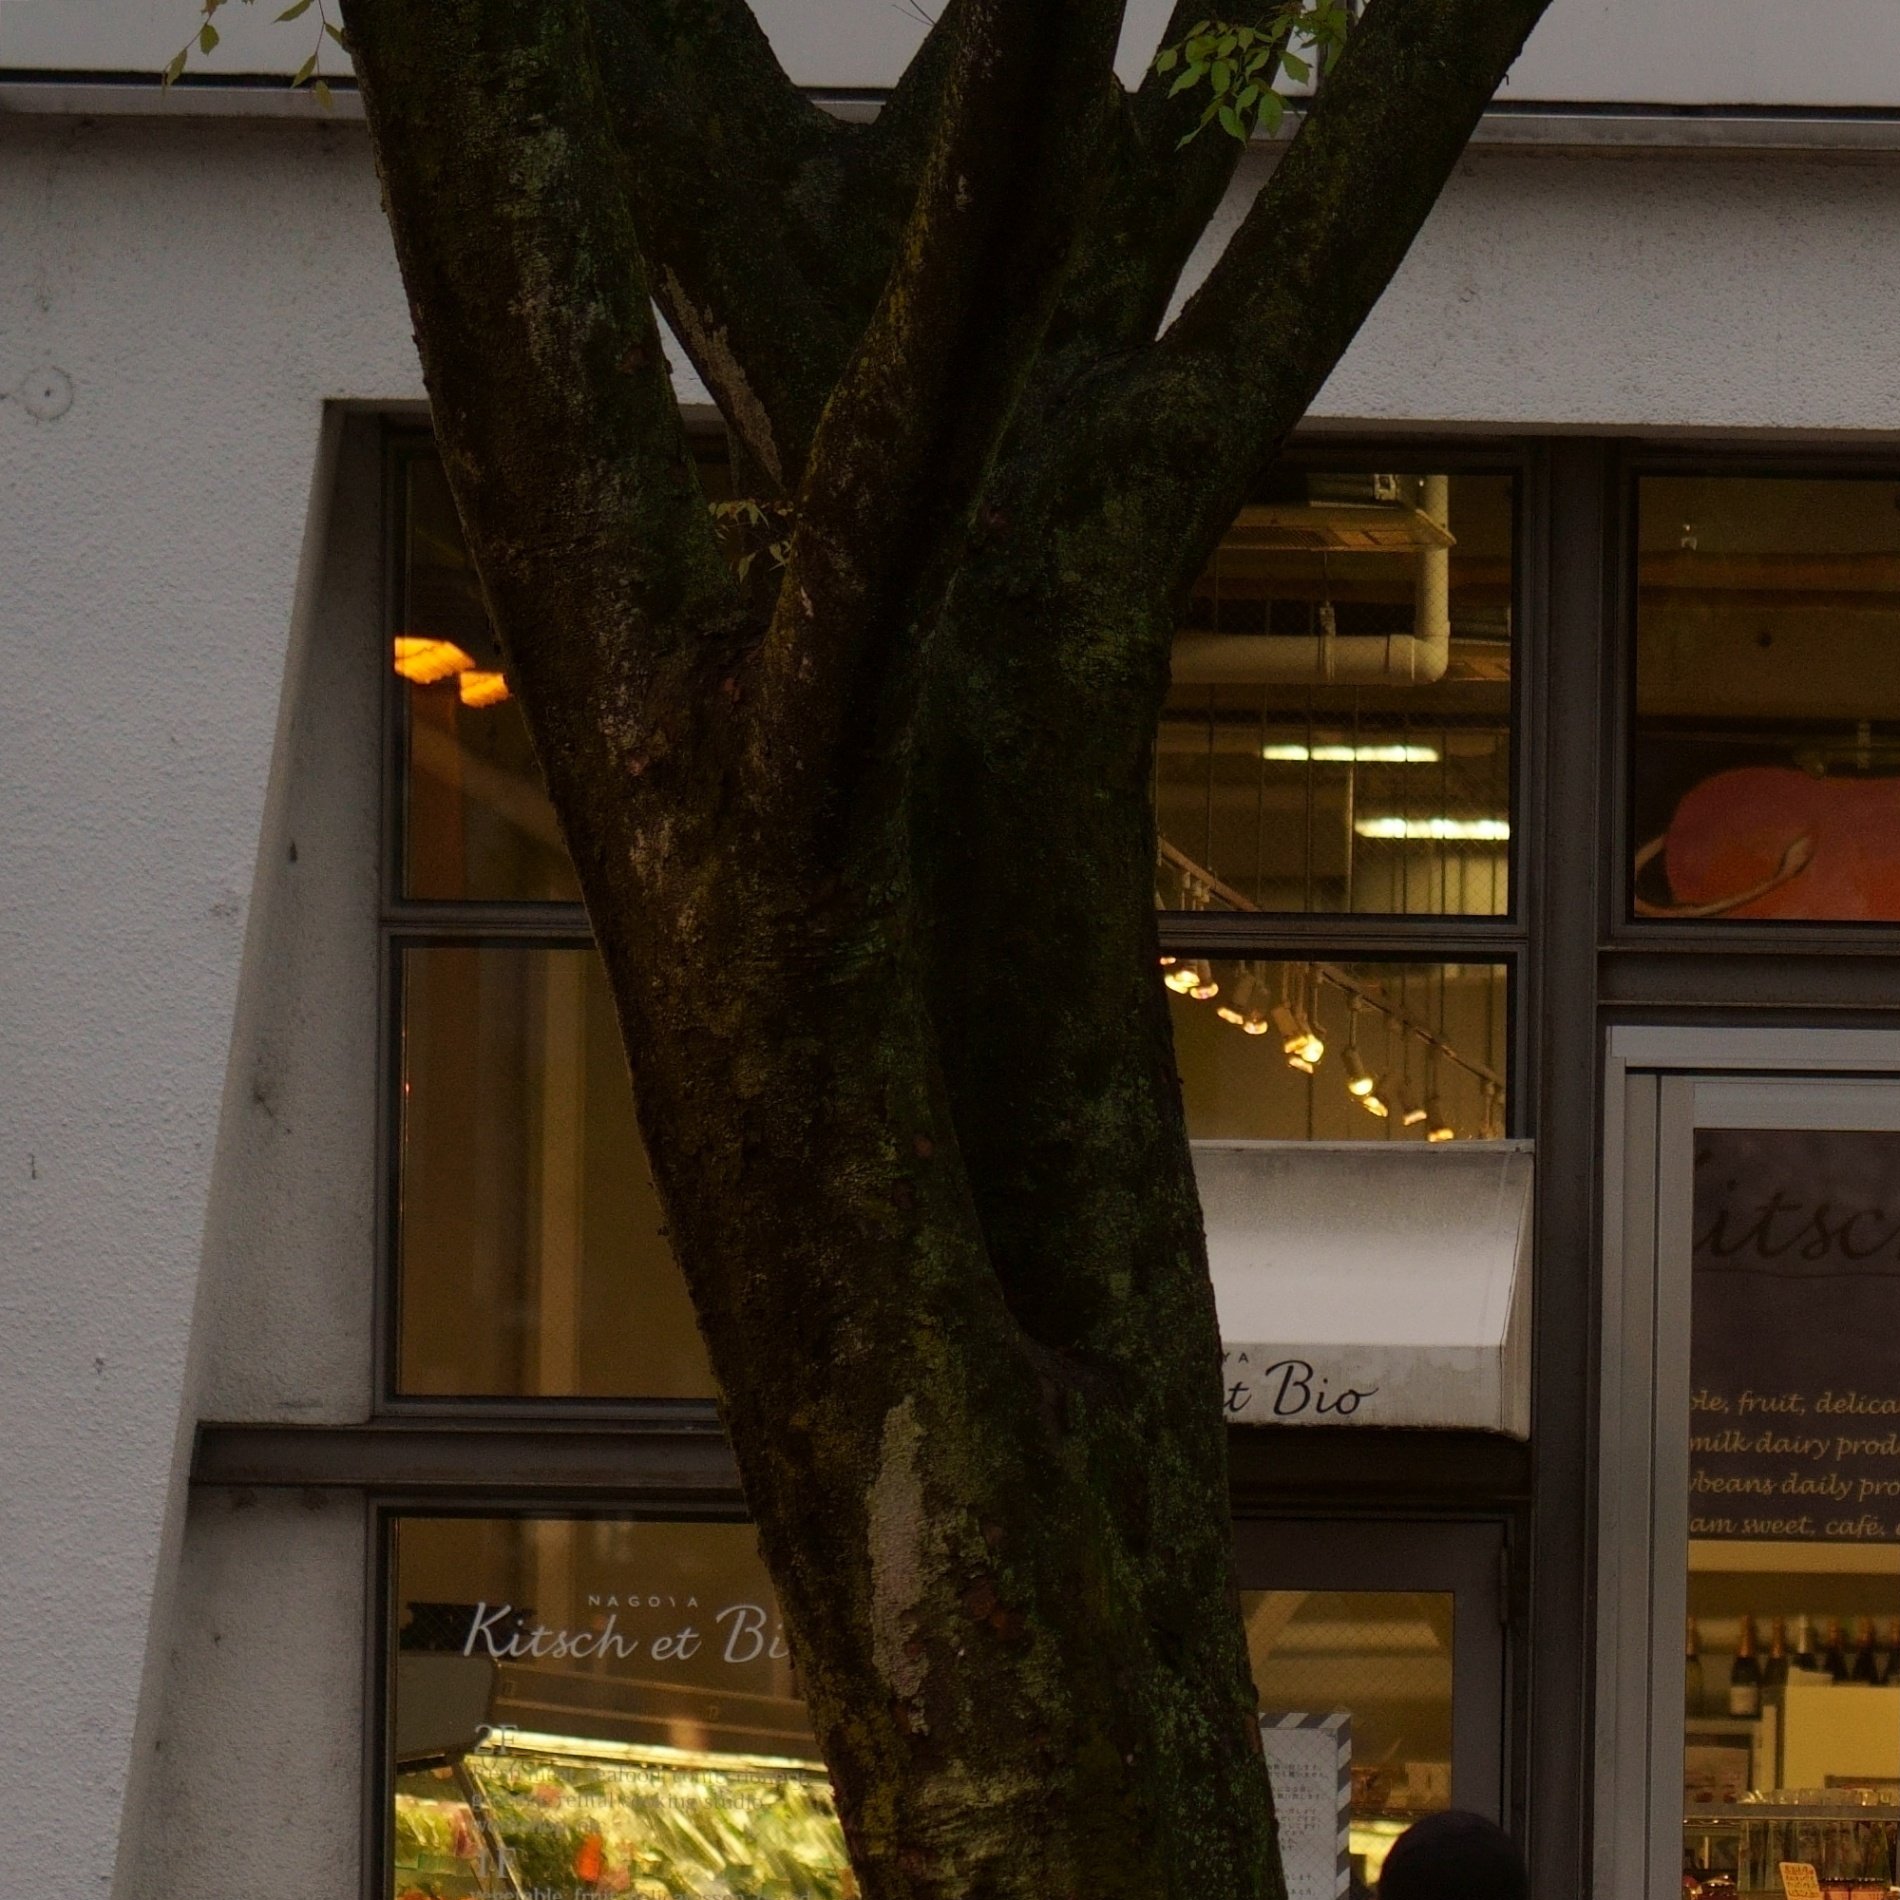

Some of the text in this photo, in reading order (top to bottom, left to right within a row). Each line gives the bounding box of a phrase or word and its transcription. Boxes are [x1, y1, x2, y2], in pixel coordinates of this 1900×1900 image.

[1265, 1360, 1379, 1416] Bio
[1738, 1390, 1806, 1416] fruit,
[1755, 1431, 1829, 1460] dairy
[1782, 1472, 1852, 1501] daily
[463, 1601, 791, 1664] Kitsch et Bi
